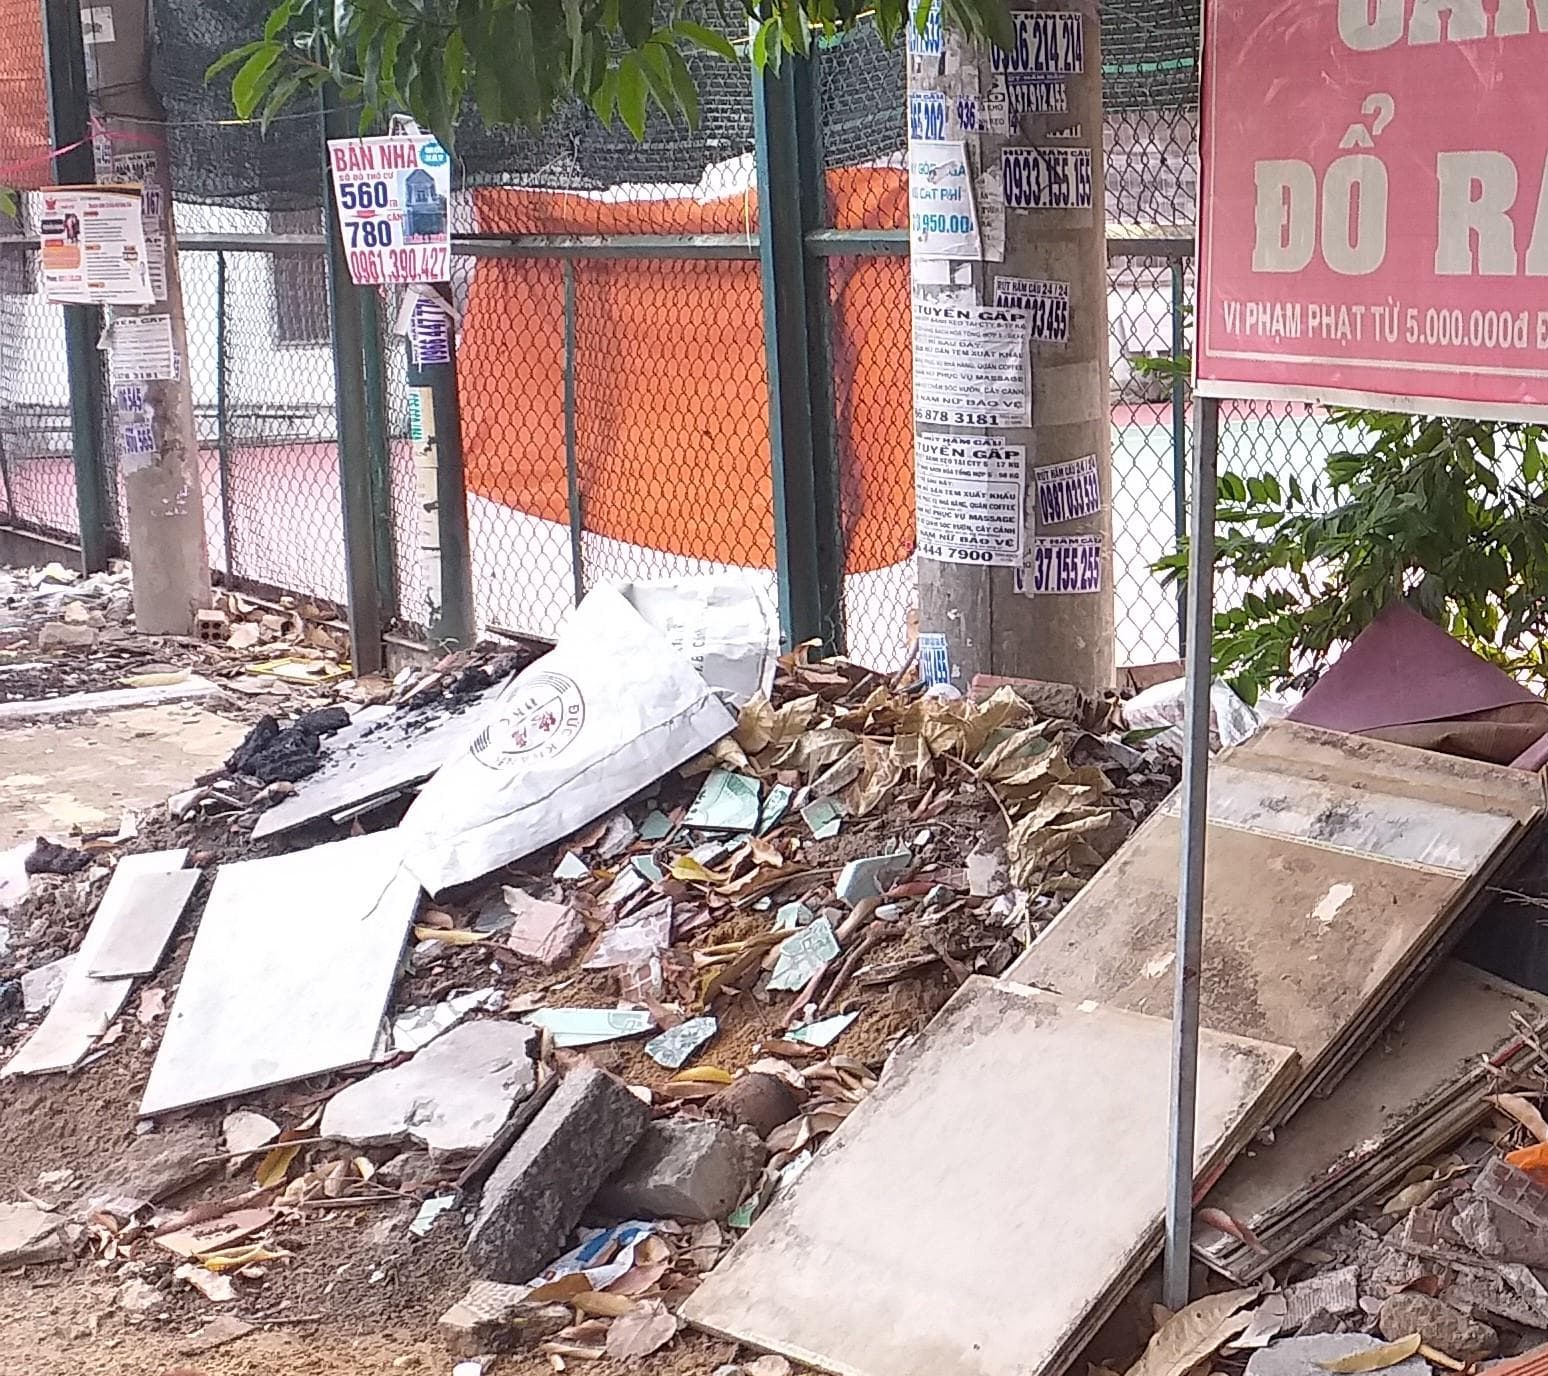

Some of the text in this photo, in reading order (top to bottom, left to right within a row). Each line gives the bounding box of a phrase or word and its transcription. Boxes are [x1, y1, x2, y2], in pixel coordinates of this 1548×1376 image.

[333, 138, 419, 172] BÁN NHÀ
[340, 181, 389, 210] 560
[1003, 156, 1093, 208] 0933.155.155
[1252, 93, 1396, 276] ĐỔ
[344, 220, 392, 249] 780
[351, 247, 448, 284] 0961.390.427
[978, 309, 1026, 322] GẤP
[1224, 300, 1241, 336] VI
[1245, 301, 1300, 344] PHẠM
[1308, 303, 1365, 346] PHẠT
[1371, 295, 1401, 343] TỪ
[1406, 308, 1529, 349] 5.000.000đ
[954, 412, 1000, 426] 3181
[972, 446, 1020, 460] GẤP
[948, 547, 994, 563] 7900
